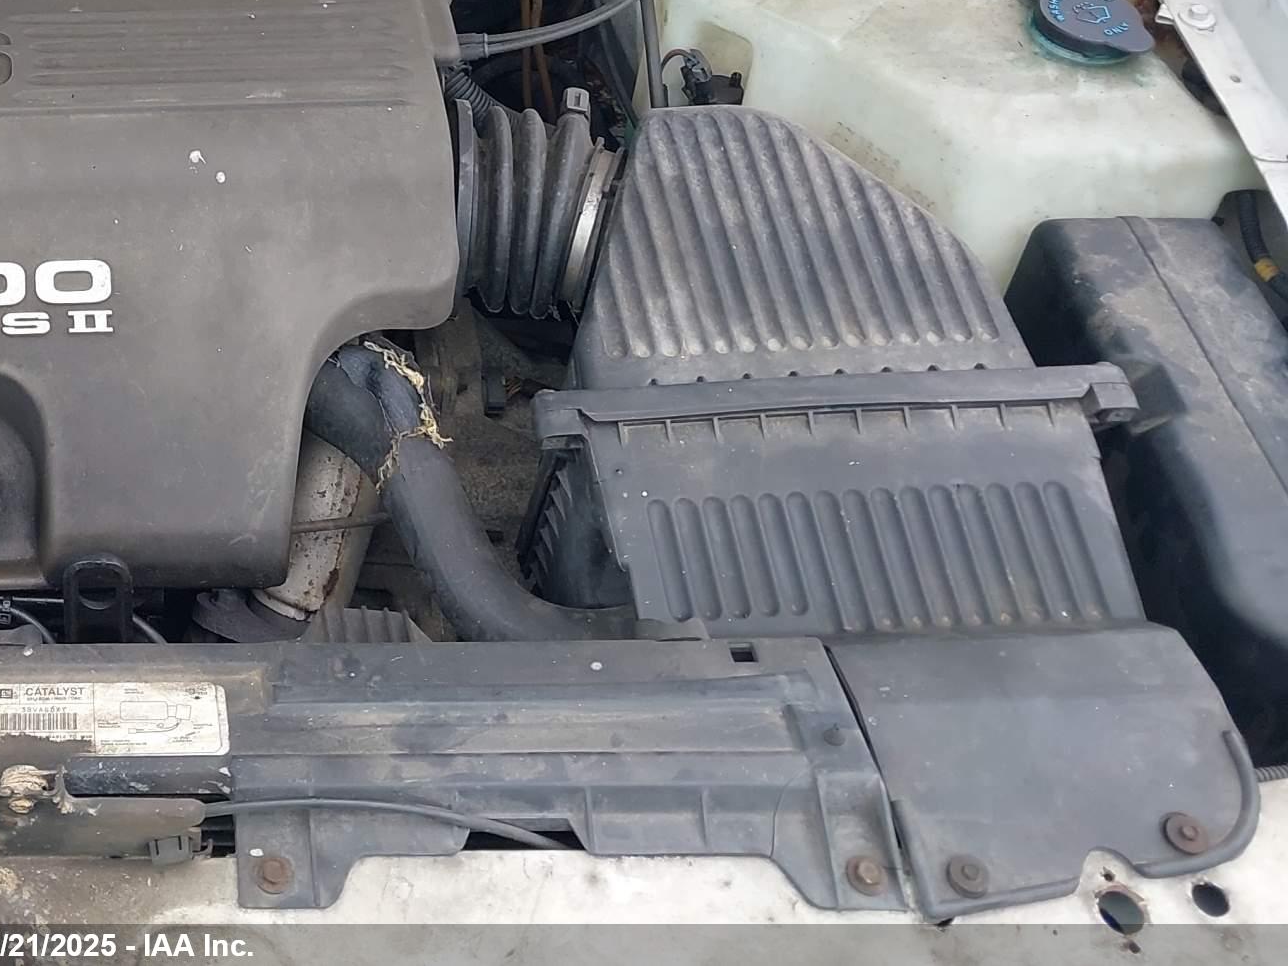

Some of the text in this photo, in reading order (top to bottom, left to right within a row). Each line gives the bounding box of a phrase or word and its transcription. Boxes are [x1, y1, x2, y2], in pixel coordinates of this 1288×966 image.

[1103, 21, 1130, 37] ONLY
[67, 309, 114, 334] II
[25, 686, 85, 697] CATALYST
